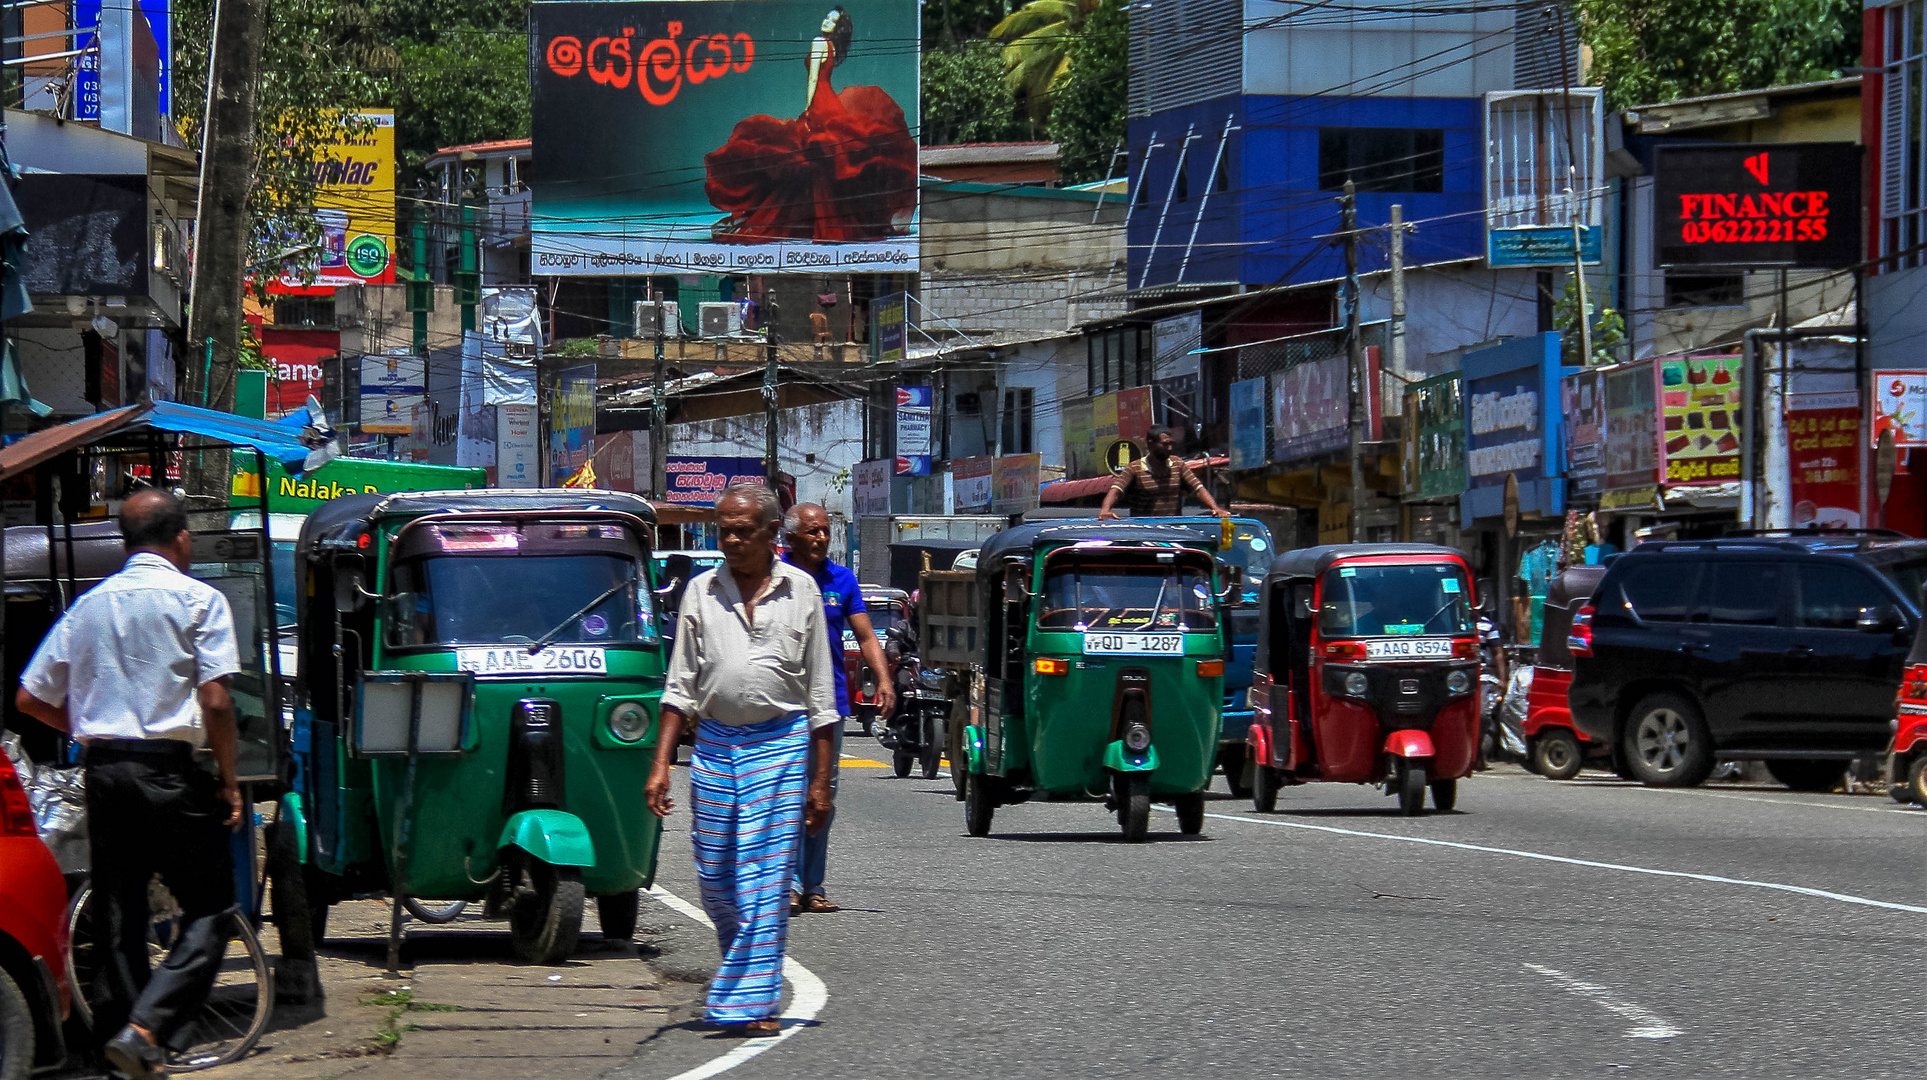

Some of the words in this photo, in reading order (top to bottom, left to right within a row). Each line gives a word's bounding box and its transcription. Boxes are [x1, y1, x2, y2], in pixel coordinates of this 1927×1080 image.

[1679, 191, 1830, 219] FINANCE
[1681, 218, 1828, 243] 0362222155
[357, 248, 379, 260] ISO
[1102, 635, 1123, 651] QD
[1141, 636, 1181, 651] 1287
[1383, 642, 1410, 655] AAQ
[1415, 642, 1451, 654] 8594
[486, 650, 534, 670] AAE
[542, 649, 602, 669] 2606
